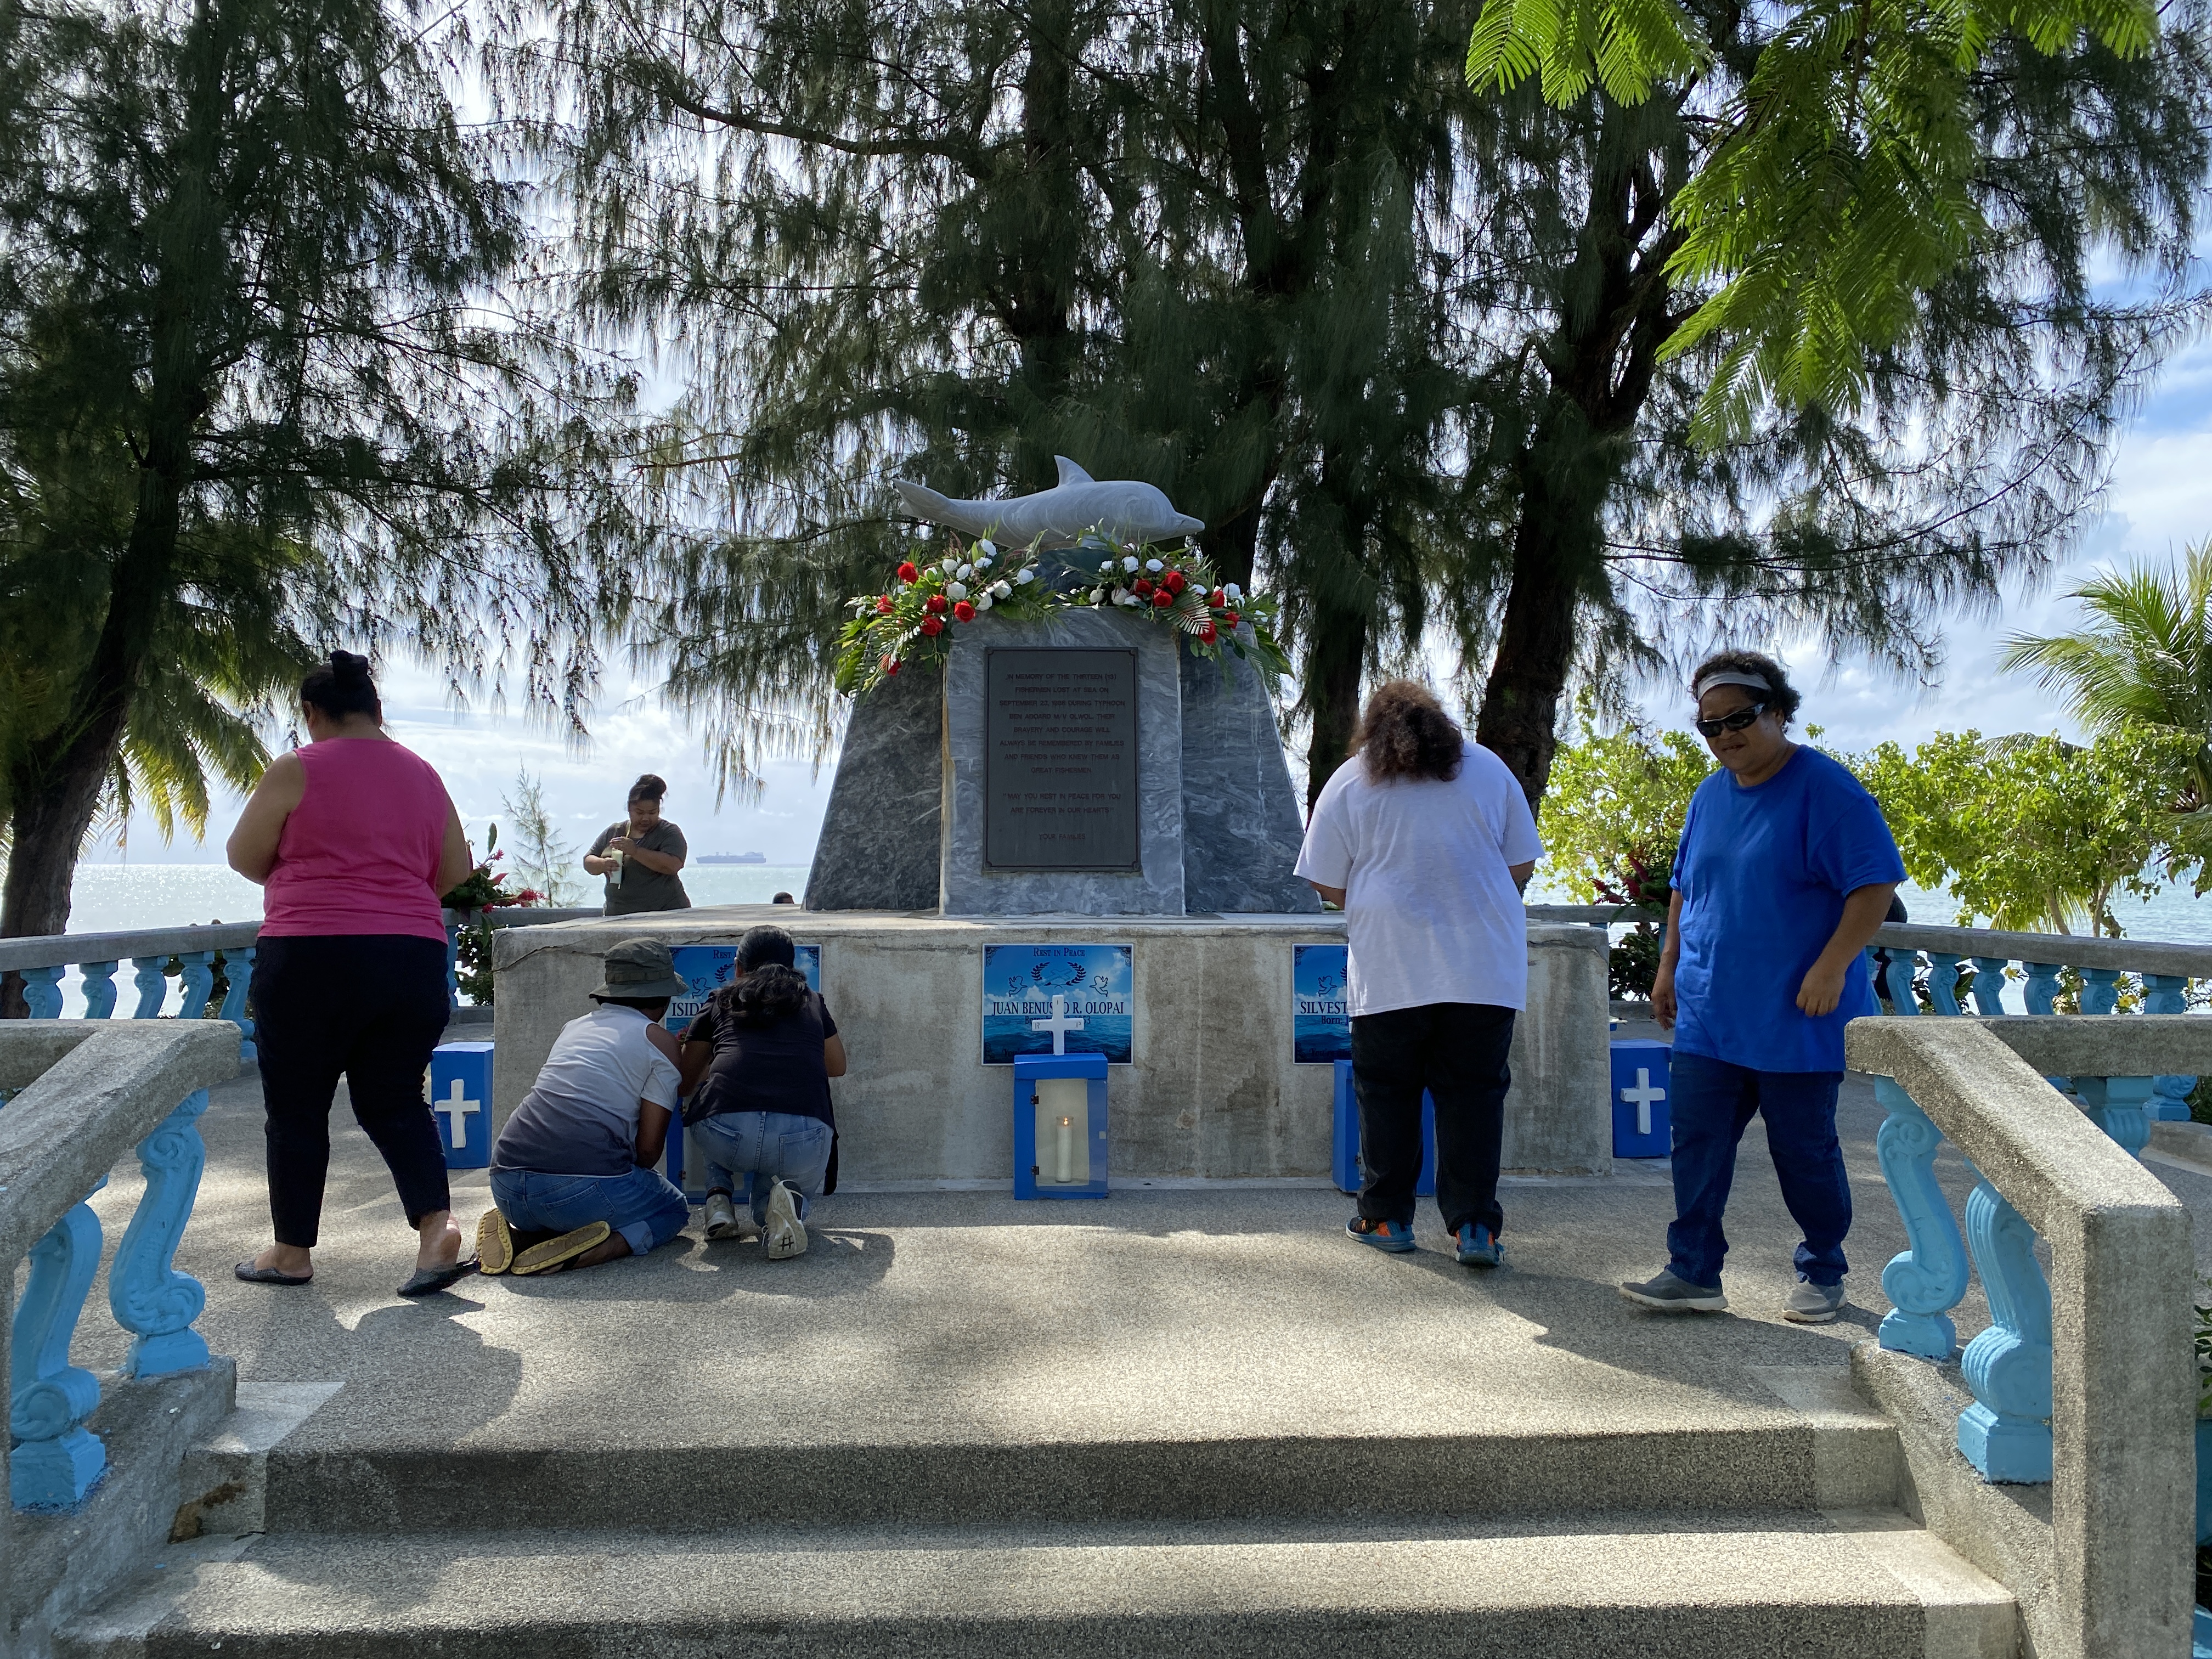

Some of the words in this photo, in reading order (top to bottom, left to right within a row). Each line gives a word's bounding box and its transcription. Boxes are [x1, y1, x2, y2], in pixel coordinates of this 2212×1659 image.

[991, 1002, 1019, 1016] JUAN
[1022, 1002, 1069, 1014] BENUSO
[1073, 1002, 1082, 1014] R.
[1086, 1002, 1124, 1014] OLOPAI
